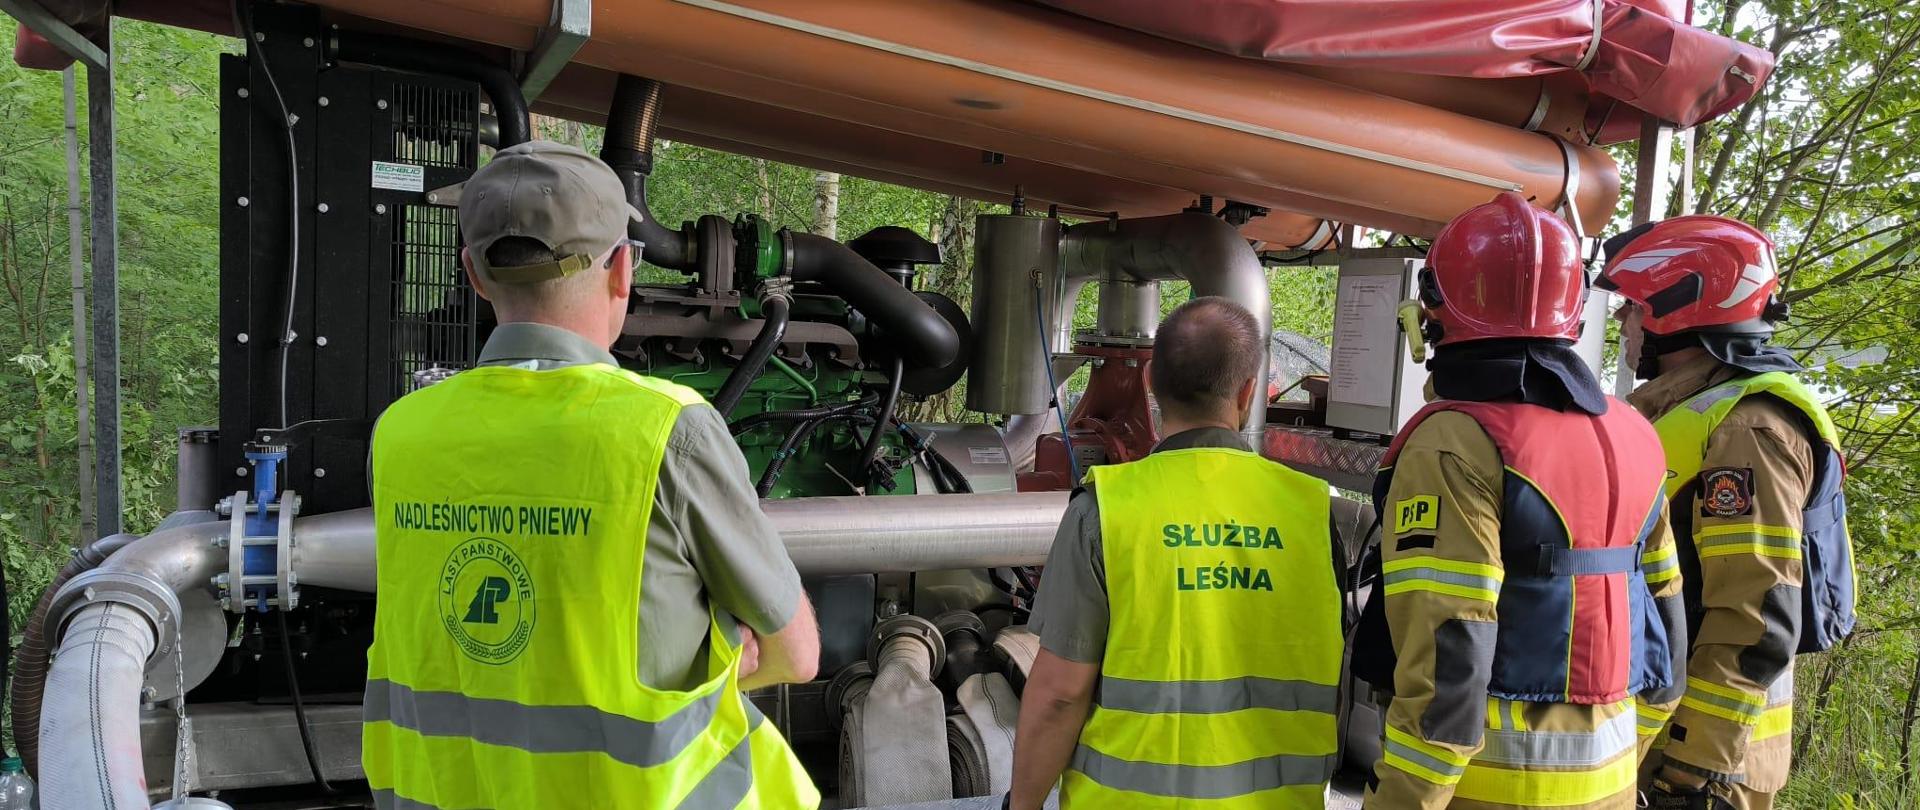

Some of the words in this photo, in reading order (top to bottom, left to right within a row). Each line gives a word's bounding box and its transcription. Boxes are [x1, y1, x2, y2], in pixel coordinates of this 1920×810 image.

[394, 496, 514, 534] NADLEŚNICTWO
[519, 506, 592, 536] PNIEWY
[1402, 501, 1429, 527] PSP
[1162, 519, 1284, 549] SŁUŻBA
[442, 556, 461, 595] LASY
[461, 539, 531, 602] PAŃSTWOWE
[1177, 561, 1274, 591] LEŚNA
